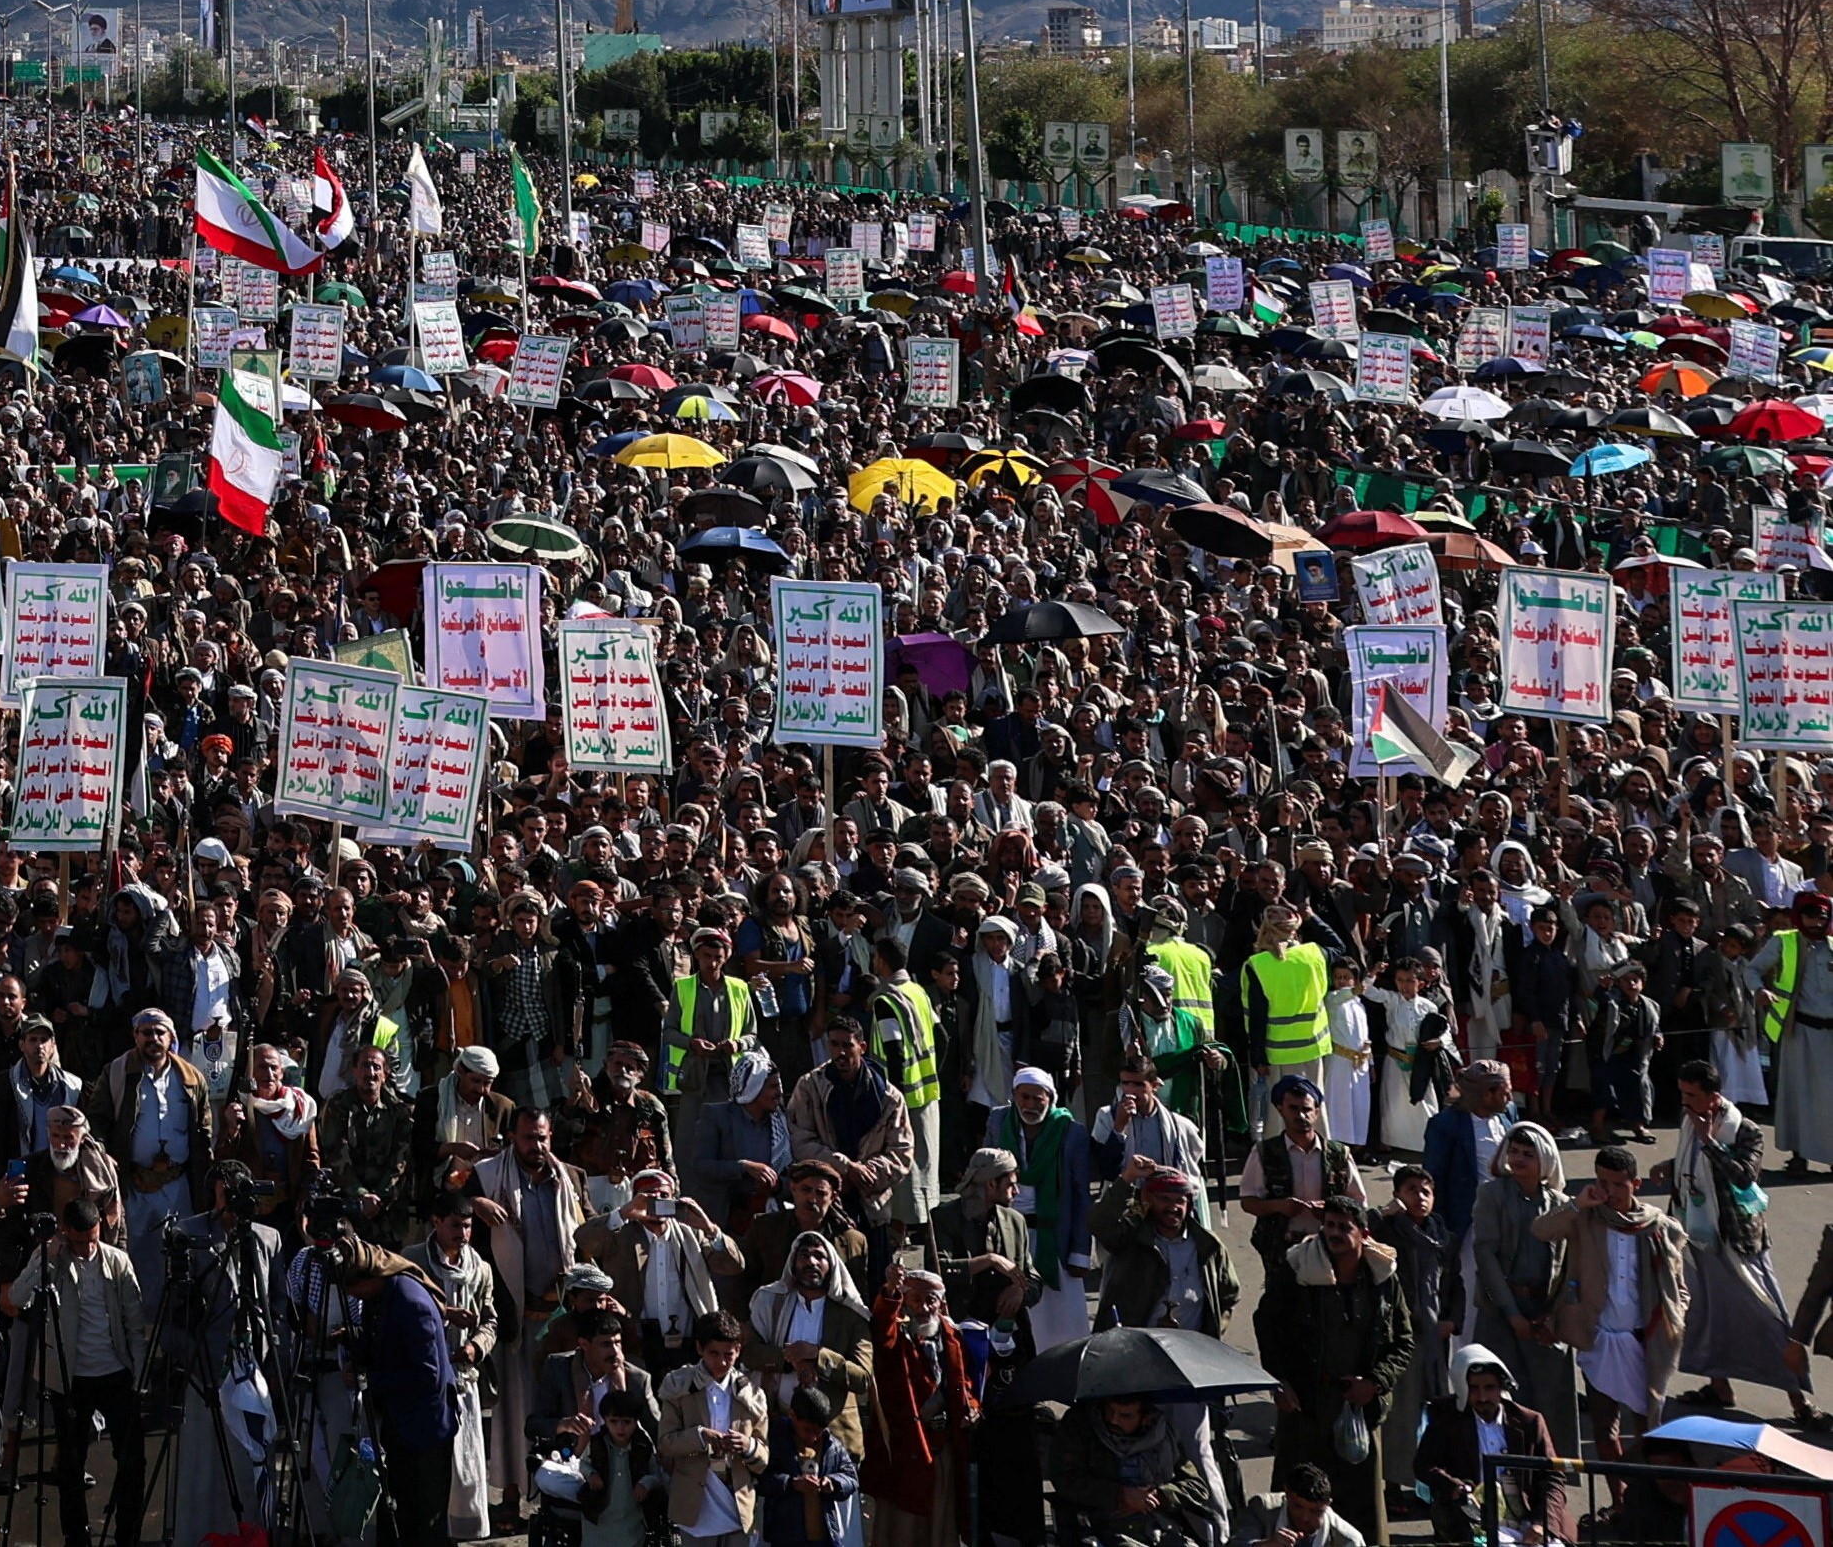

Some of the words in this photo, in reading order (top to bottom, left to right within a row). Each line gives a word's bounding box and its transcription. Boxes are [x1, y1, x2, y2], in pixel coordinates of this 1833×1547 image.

[439, 574, 523, 604] قاطعوا
[1514, 583, 1603, 614] قاطعوا
[441, 607, 485, 636] الأمريكية
[785, 594, 837, 627] أكبر
[838, 600, 871, 623] الله
[486, 611, 525, 636] البضائع
[1512, 618, 1558, 646] الأمريكية
[785, 628, 829, 647] لأمريكا
[831, 633, 871, 649] الموت
[1560, 624, 1602, 650] البضائع
[786, 654, 829, 674] لإسرائيل
[831, 658, 871, 674] الموت
[442, 665, 528, 693] الإسرائيلية
[785, 678, 816, 696] اليهود
[819, 681, 838, 698] على
[841, 682, 871, 697] اللعنة
[1510, 674, 1600, 706] الإسرائيلية
[296, 678, 355, 707] أكبر
[355, 687, 390, 712] الله
[294, 707, 344, 727] لأمريكا
[783, 699, 827, 726] للإسلام
[831, 701, 871, 727] النصر
[347, 718, 387, 738] الموت
[292, 732, 342, 752] لإسرائيل
[345, 742, 384, 759] الموت
[289, 756, 324, 773] اليهود
[328, 762, 348, 776] على
[352, 765, 382, 782] اللعنة
[286, 773, 334, 803] للإسلام
[337, 782, 381, 808] النصر
